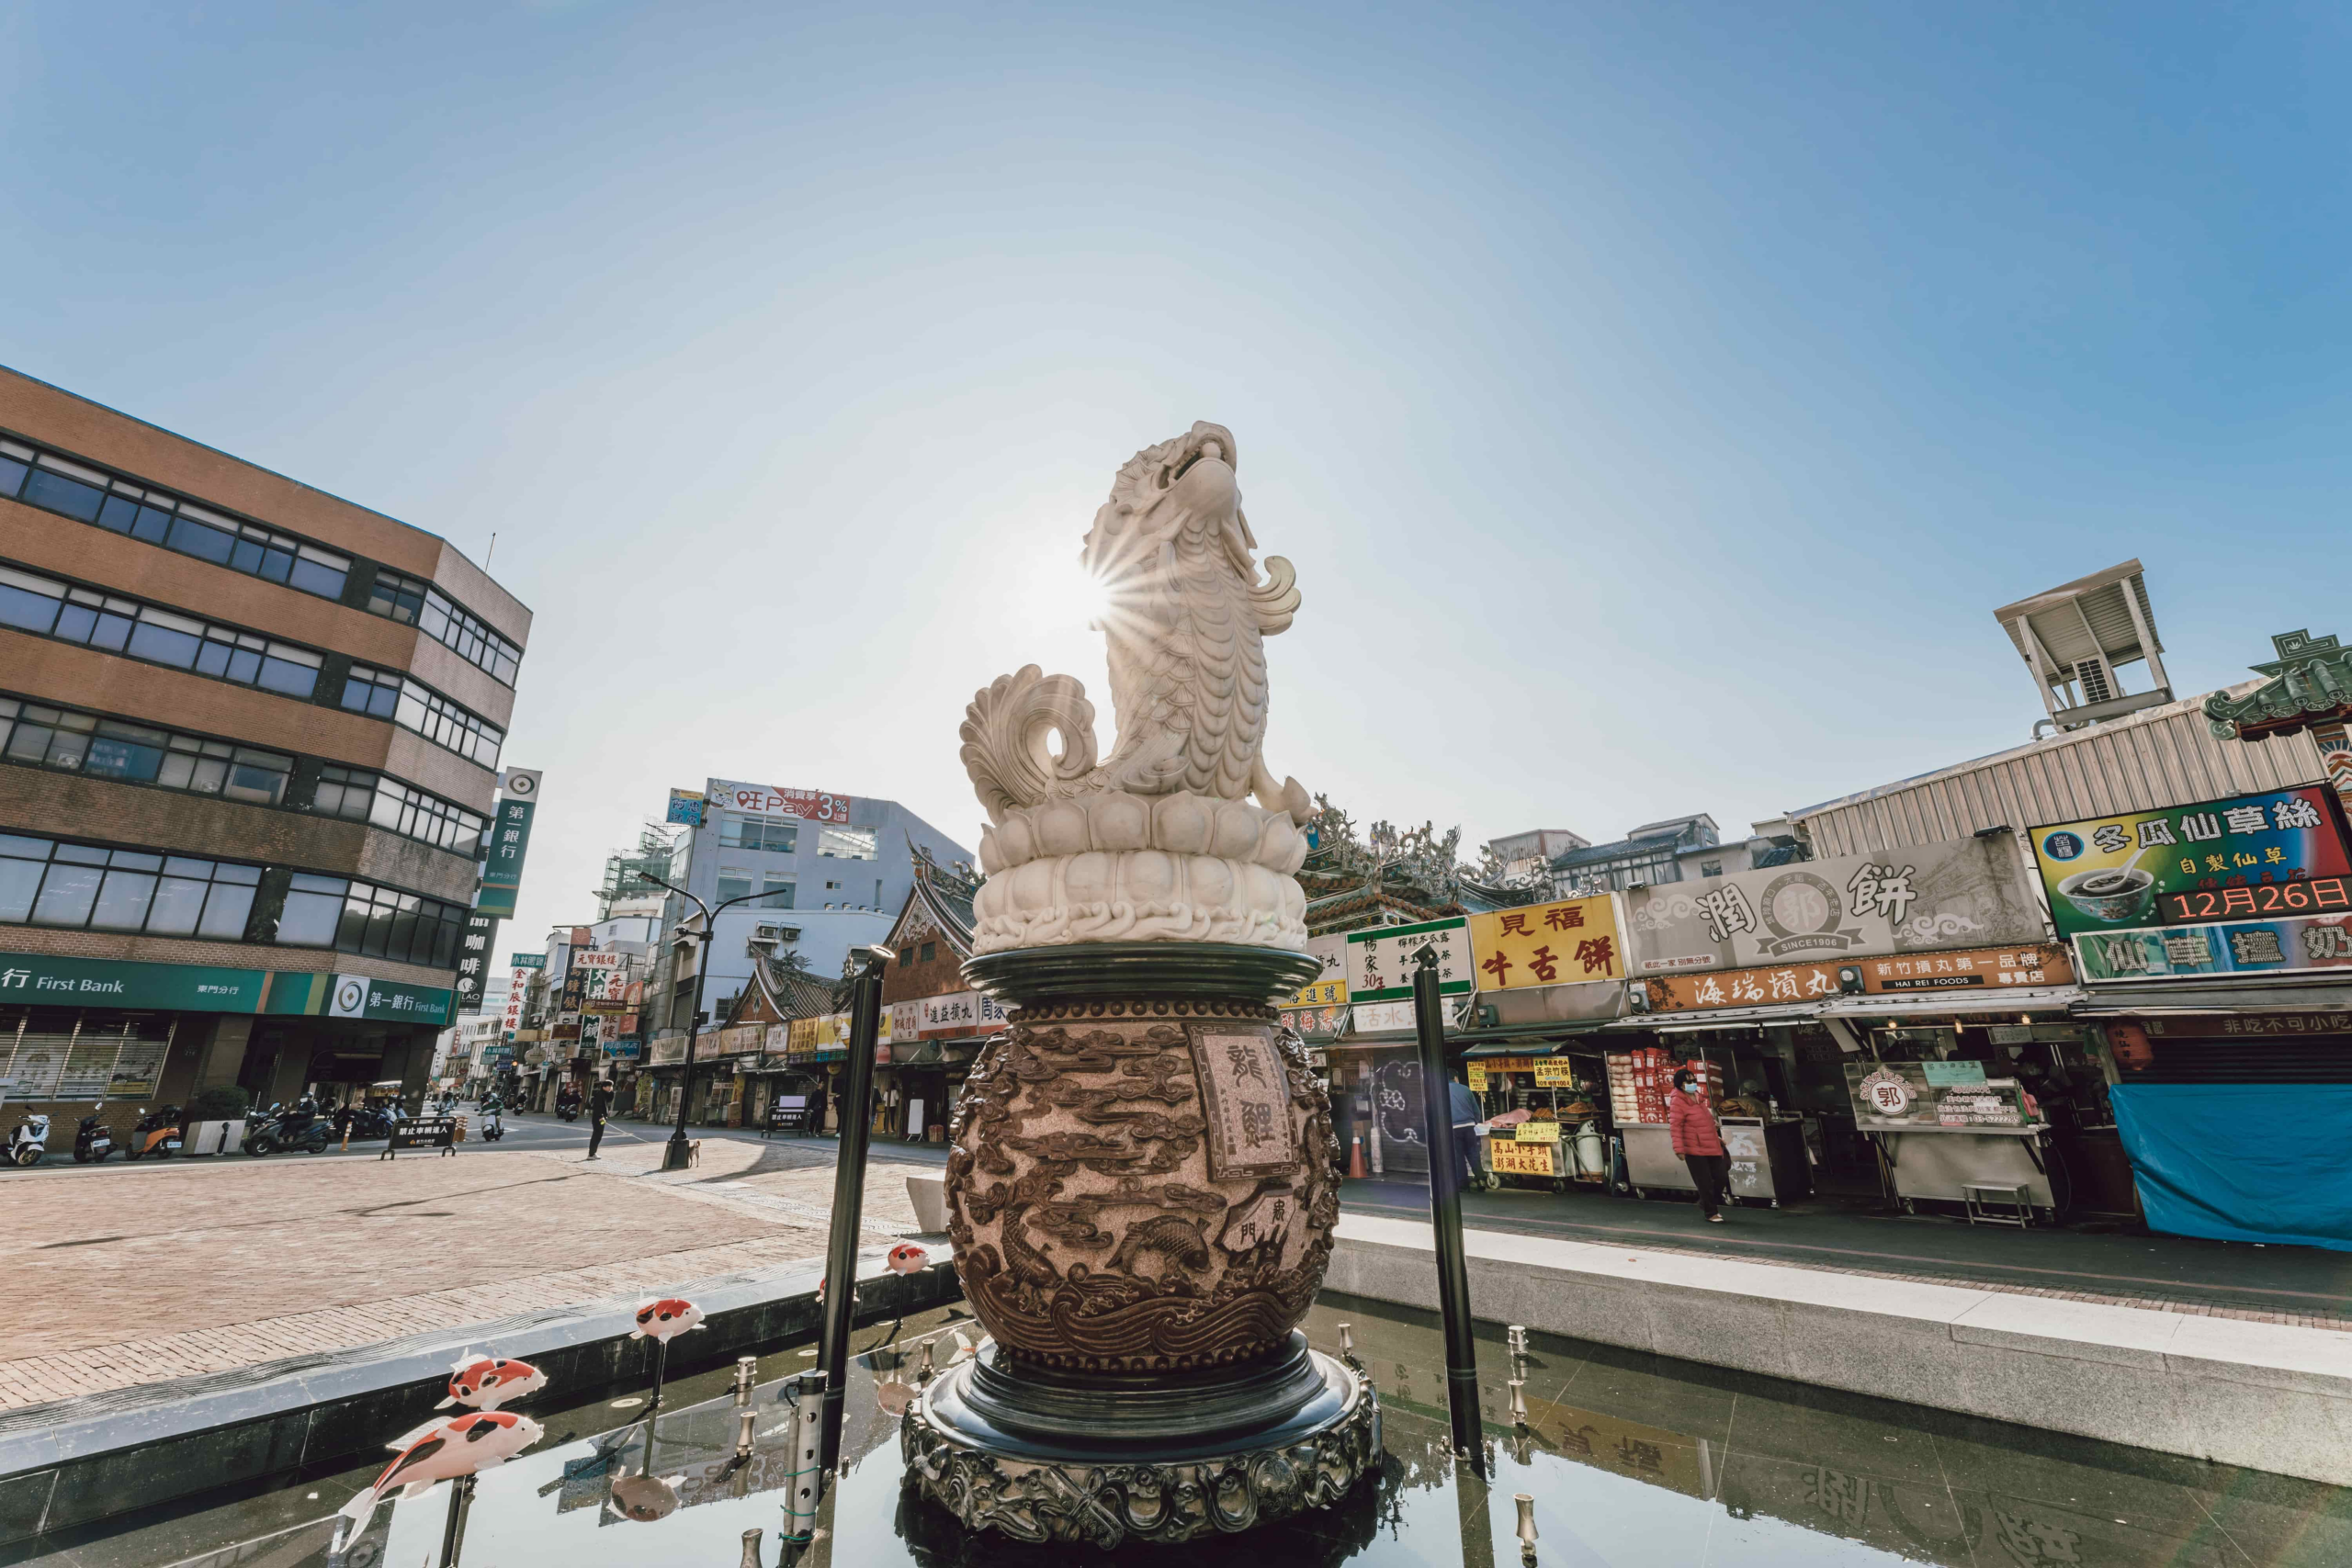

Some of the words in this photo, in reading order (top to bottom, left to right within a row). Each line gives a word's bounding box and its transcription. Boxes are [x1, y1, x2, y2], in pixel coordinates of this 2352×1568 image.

[784, 788, 817, 802] 消費享
[671, 797, 701, 813] 阿忠
[670, 812, 698, 825] 冰店
[2093, 797, 2324, 854] 冬瓜仙草絲
[500, 805, 526, 859] 第一銀行
[2179, 846, 2288, 874] 自製仙草
[1783, 874, 1804, 886] 元祖
[2173, 877, 2350, 919] 12月26日
[1781, 938, 1838, 952] SINCE1906
[512, 955, 545, 966] 小林眼鏡
[577, 953, 617, 965] 元寶銀樓
[1363, 934, 1379, 974] 楊家
[1398, 950, 1452, 966] 手工茶
[1481, 935, 1614, 987] 牛舌餅
[1877, 953, 2039, 976] 新竹摃丸第一品牌
[1, 968, 31, 988] 行
[36, 976, 75, 991] First
[79, 979, 125, 994] Bank
[1363, 974, 1386, 997] 30年
[1895, 980, 1911, 988] HAI
[1916, 979, 1930, 987] REI
[1934, 977, 1969, 987] FOODS
[1997, 970, 2045, 986] 專賣店
[197, 984, 239, 996] 東門分行
[369, 991, 414, 1010] 第一銀行
[414, 1001, 429, 1013] First
[430, 1004, 446, 1014] Bank
[505, 968, 526, 1030] 金和辰銀樓
[899, 1005, 913, 1016] 新竹
[1281, 1009, 1333, 1032] 酸梅湯
[2223, 1014, 2352, 1034] 非吃不可小吃
[1877, 1087, 1901, 1107] 郭
[399, 1126, 448, 1136] 禁止車輛進入
[1494, 1156, 1550, 1173] 澎湖大花生
